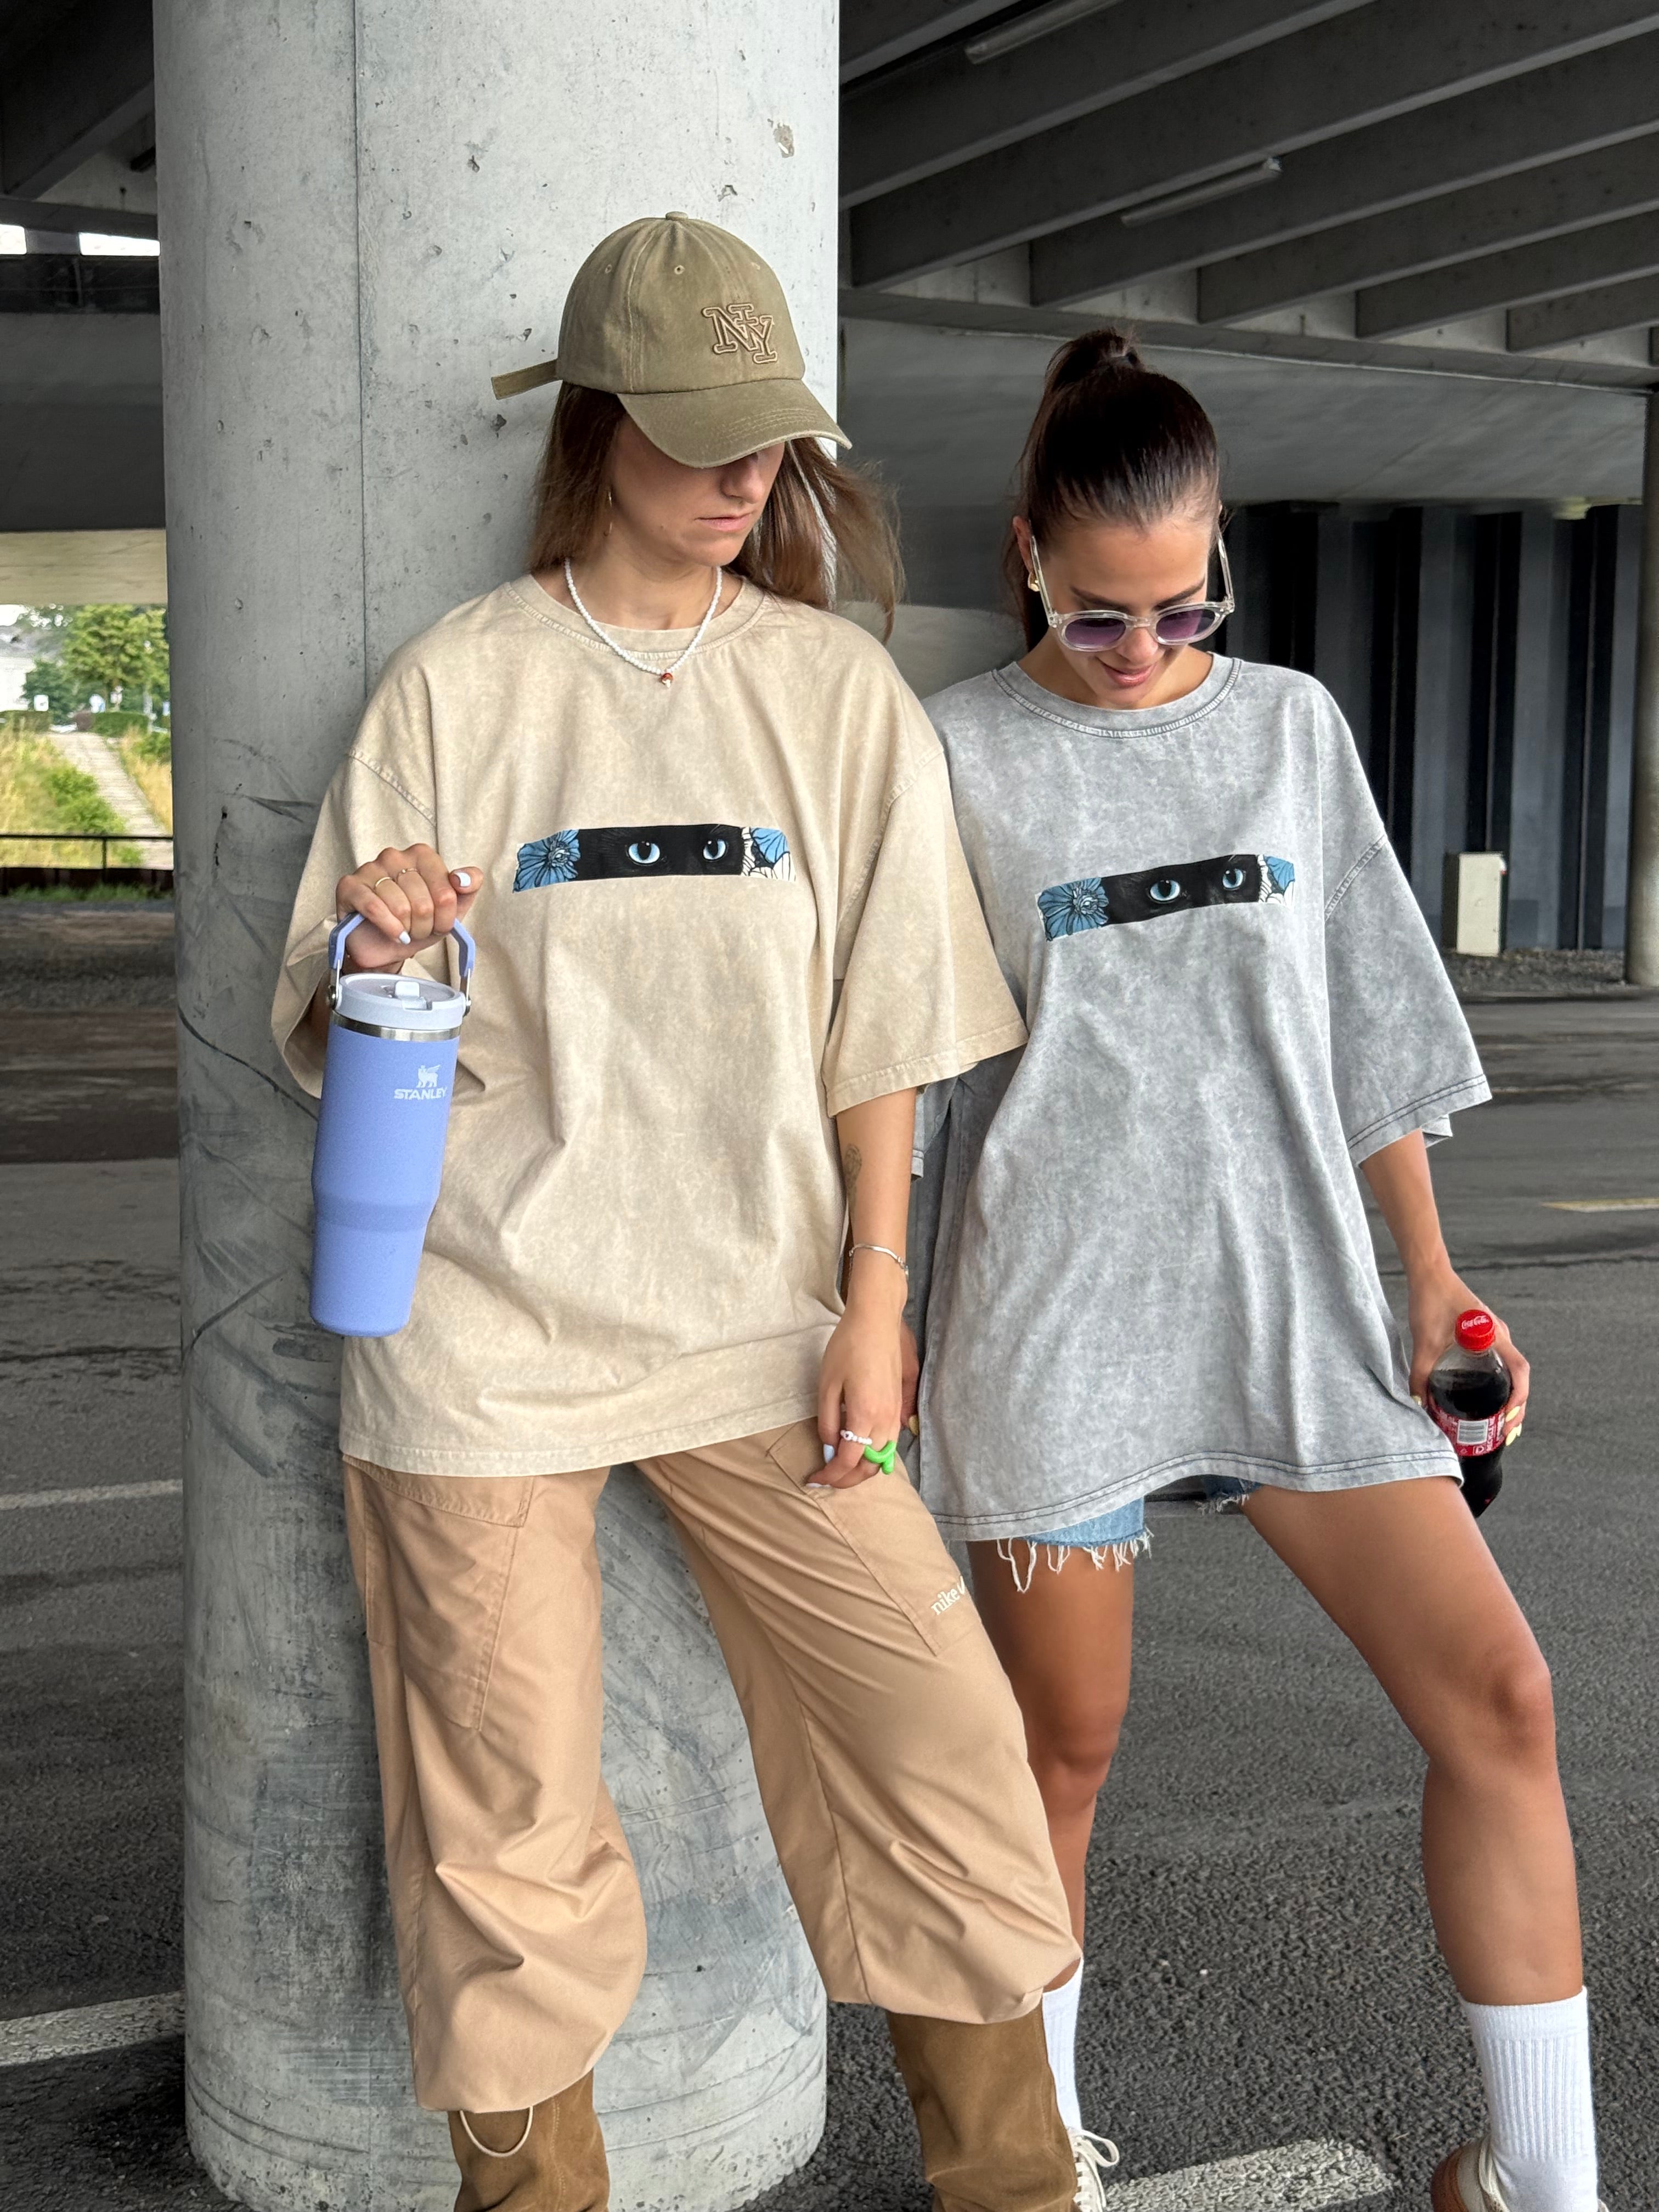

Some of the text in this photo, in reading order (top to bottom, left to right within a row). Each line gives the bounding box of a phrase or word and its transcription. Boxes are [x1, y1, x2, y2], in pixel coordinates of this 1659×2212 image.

[702, 303, 778, 364] NY
[393, 1087, 448, 1101] STANLEY
[930, 1589, 960, 1615] nike
